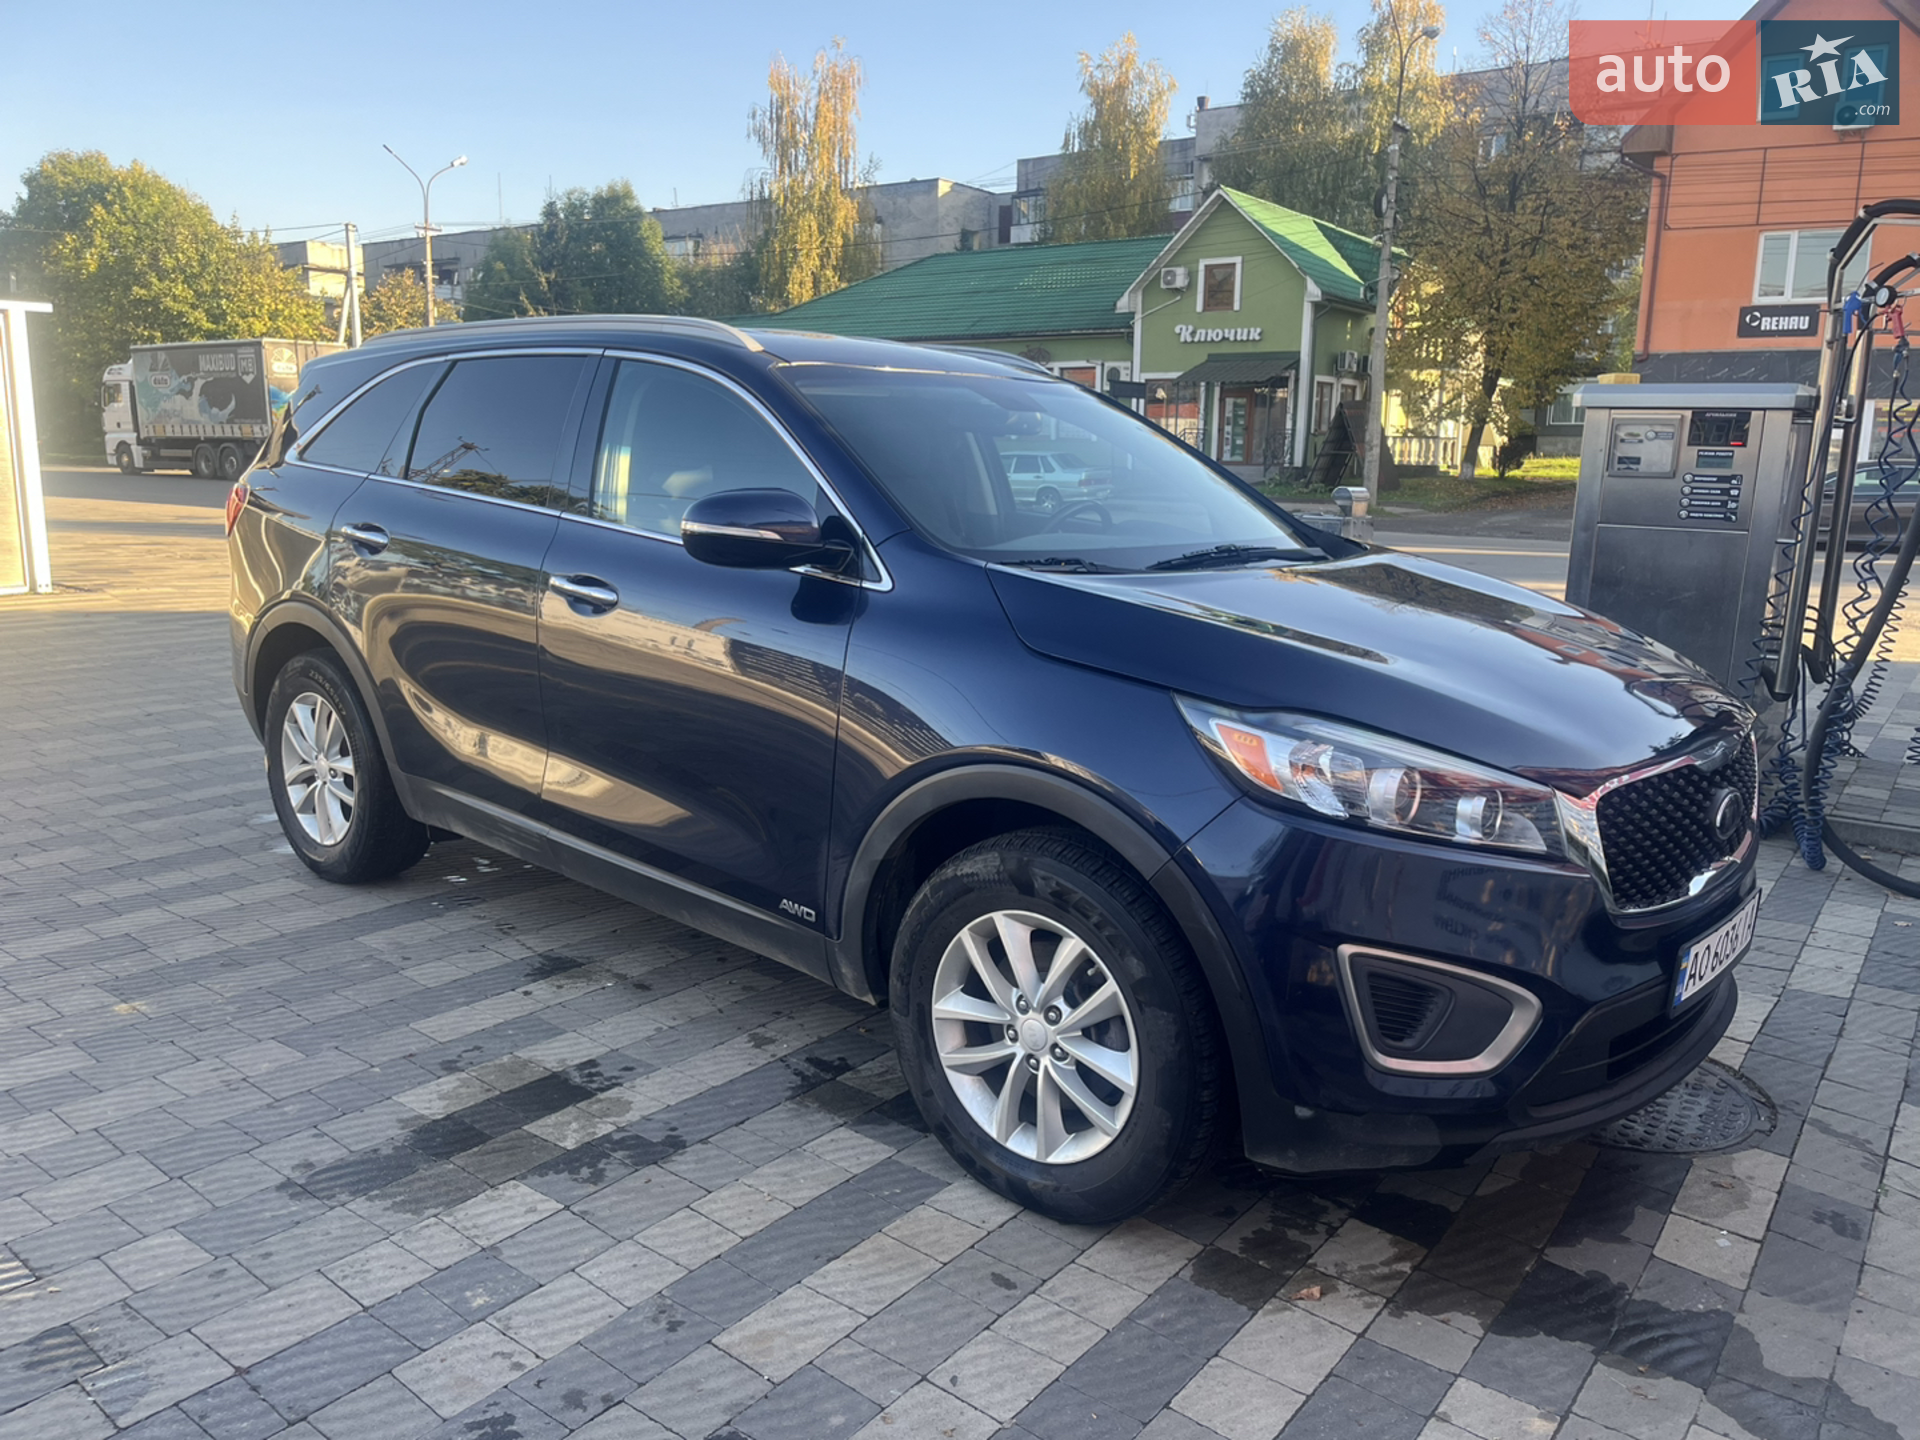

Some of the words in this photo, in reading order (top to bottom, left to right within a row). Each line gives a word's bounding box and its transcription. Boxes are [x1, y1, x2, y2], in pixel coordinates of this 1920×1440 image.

[1761, 316, 1810, 331] REHAU
[1174, 324, 1262, 343] Ключик
[198, 353, 236, 371] MAXIBUD
[779, 898, 816, 922] AWD
